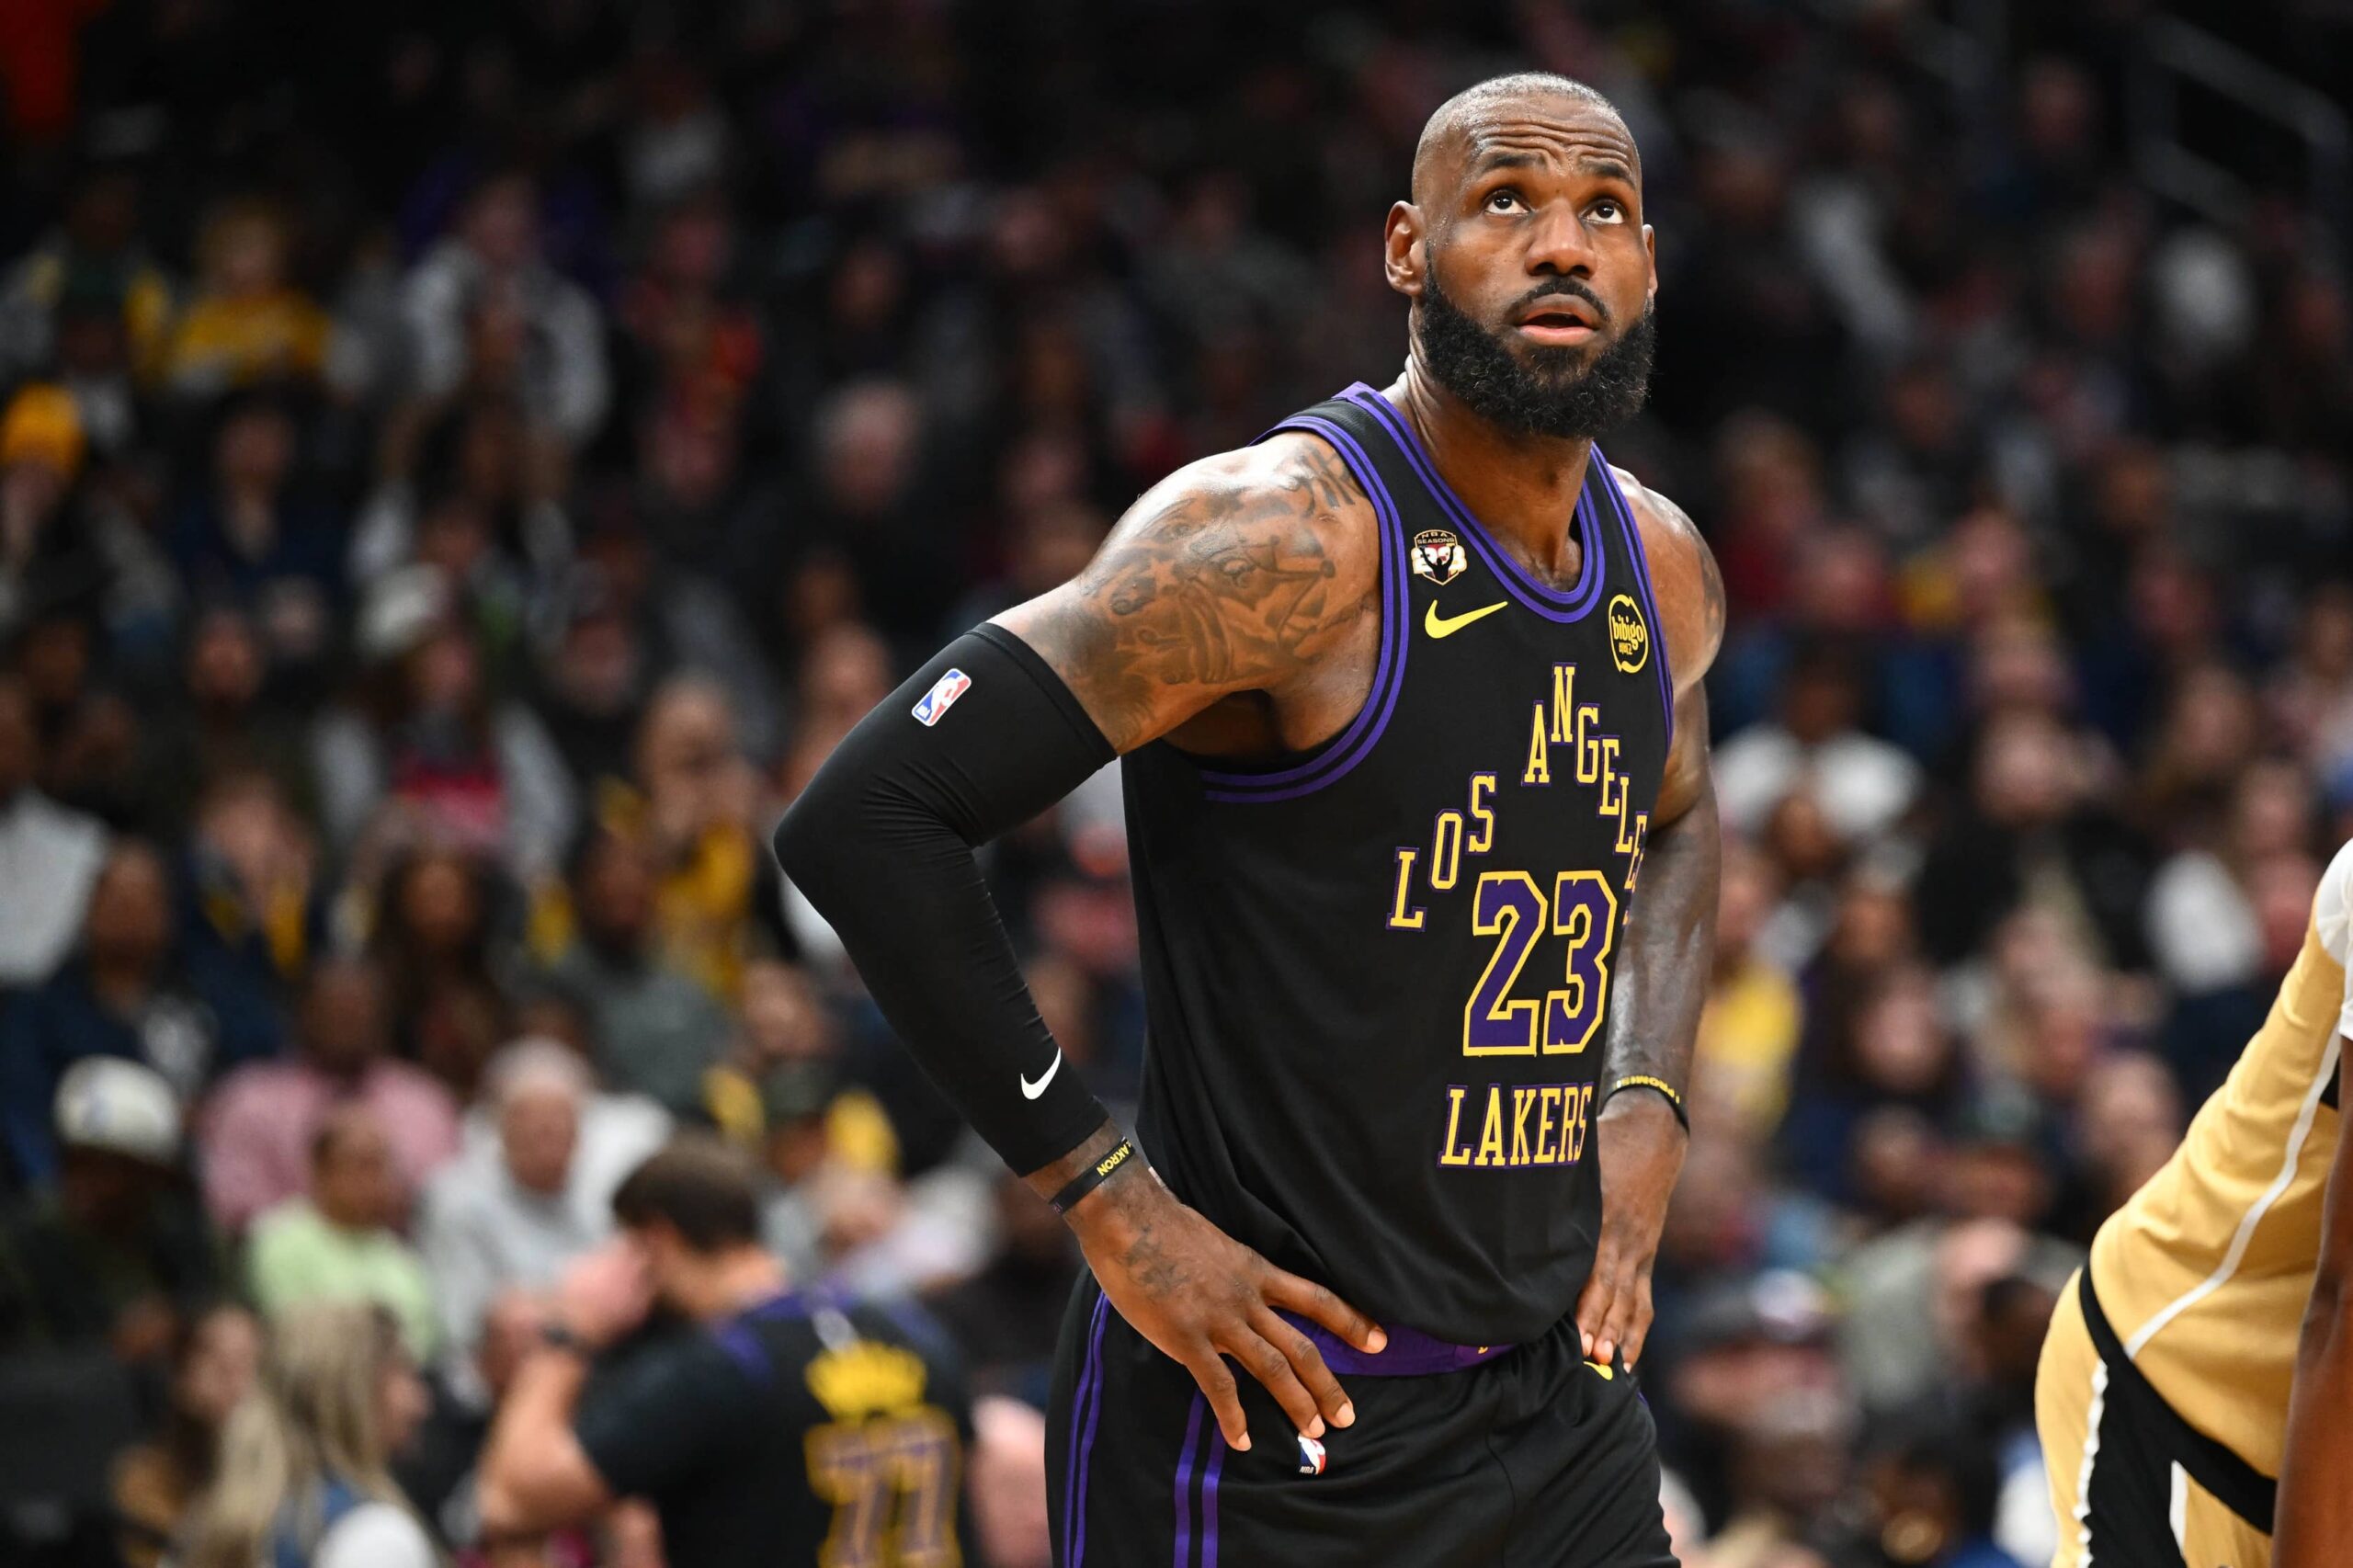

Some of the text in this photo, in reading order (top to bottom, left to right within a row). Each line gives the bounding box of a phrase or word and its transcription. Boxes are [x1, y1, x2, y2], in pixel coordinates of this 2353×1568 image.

[1611, 614, 1644, 651] bibigo
[1386, 771, 1497, 932] LOS
[1463, 870, 1617, 1057] 23
[1097, 1144, 1130, 1176] AKRON
[1438, 1083, 1595, 1169] LAKERS
